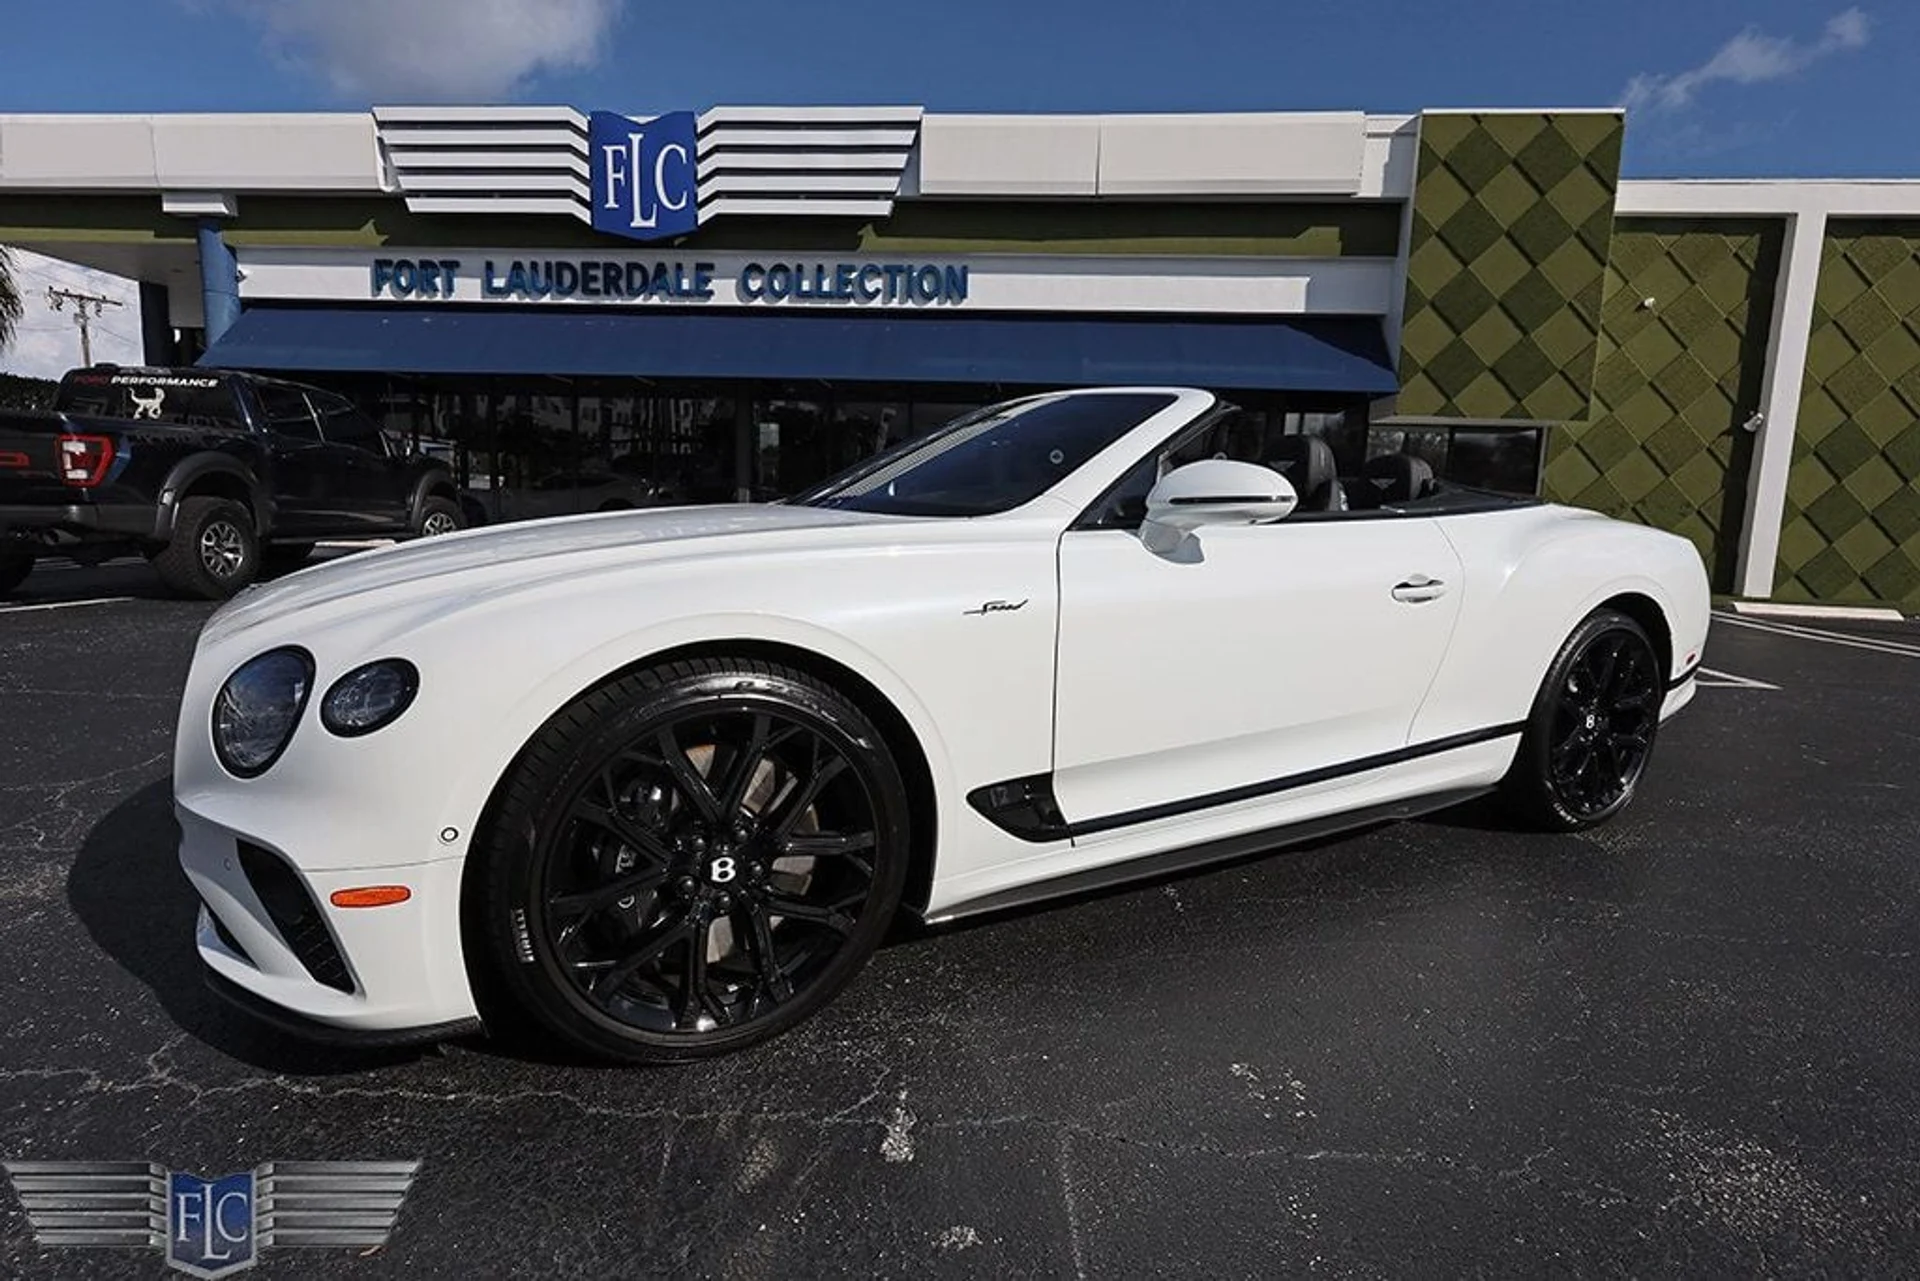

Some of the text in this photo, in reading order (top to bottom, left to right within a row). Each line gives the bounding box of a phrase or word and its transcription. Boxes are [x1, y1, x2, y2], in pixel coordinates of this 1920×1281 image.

[601, 131, 689, 230] FLC
[371, 258, 970, 302] FORT LAUDERDALE COLLECTION
[110, 375, 219, 388] PERFORMANCE
[710, 856, 737, 883] B
